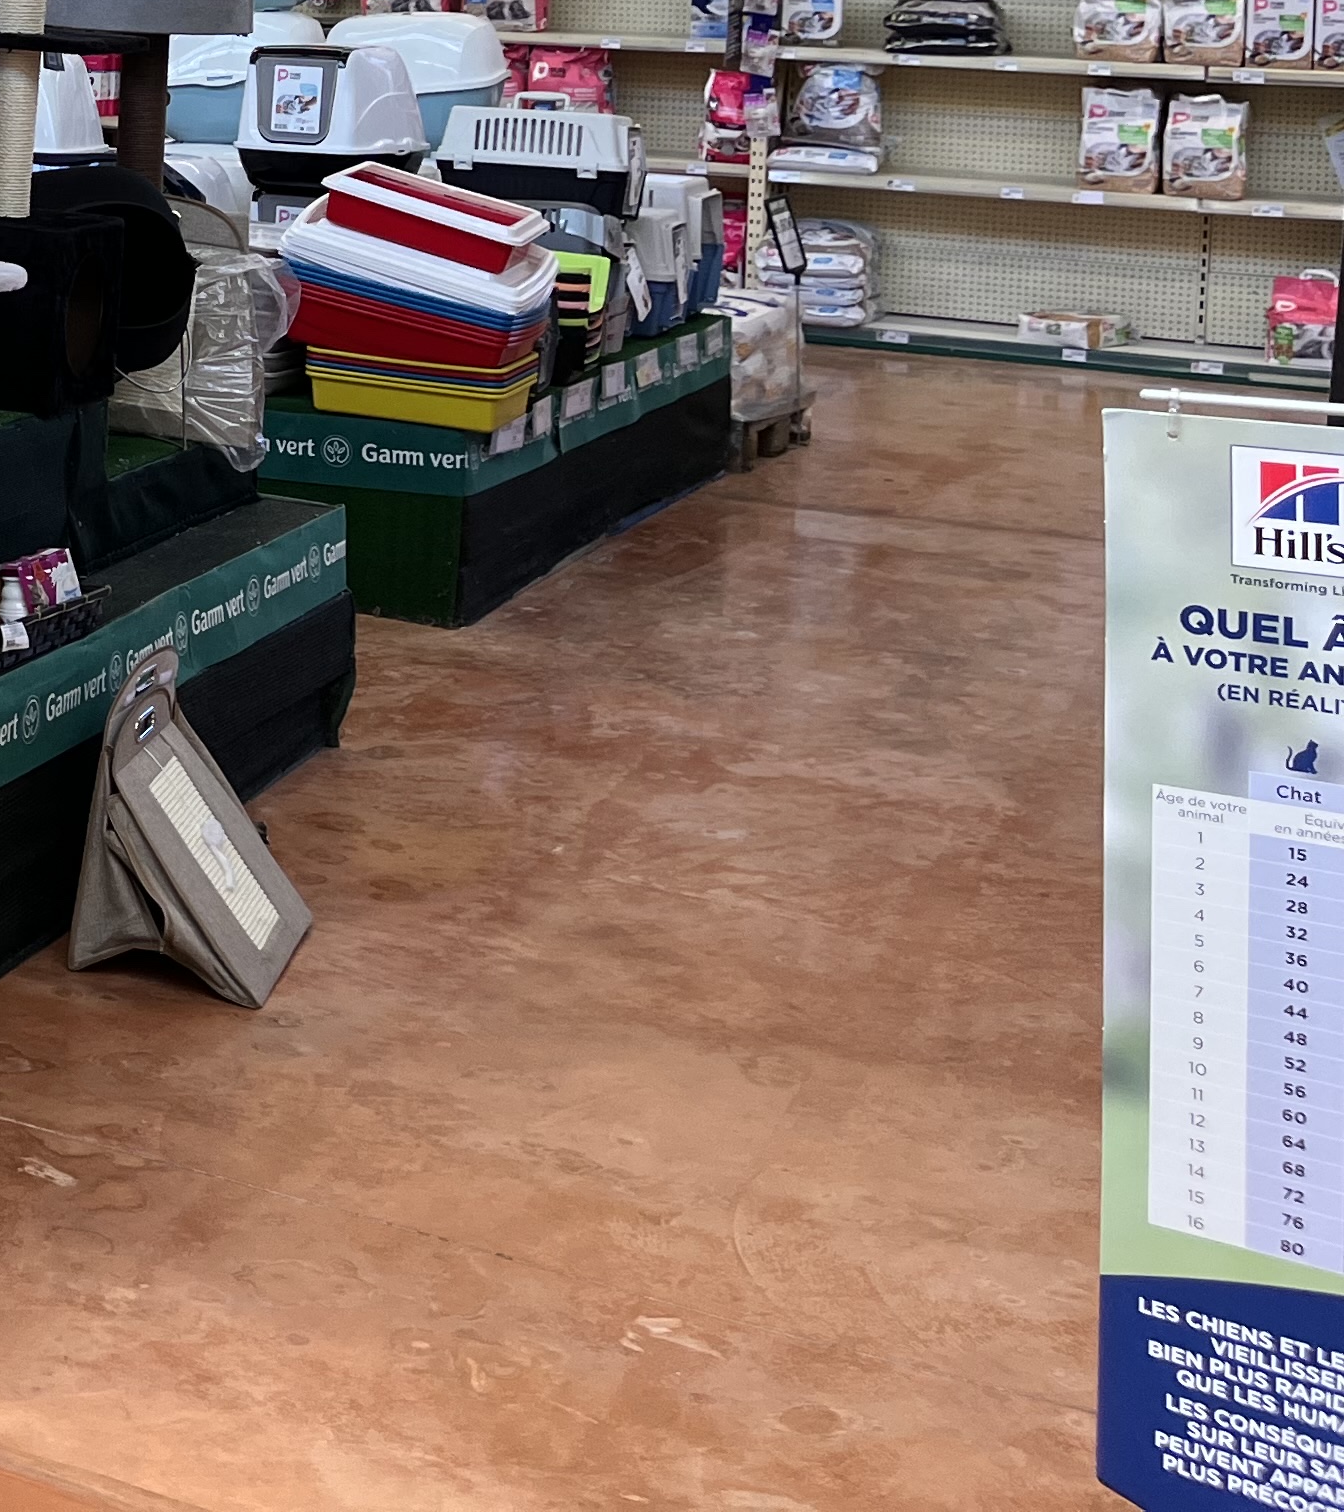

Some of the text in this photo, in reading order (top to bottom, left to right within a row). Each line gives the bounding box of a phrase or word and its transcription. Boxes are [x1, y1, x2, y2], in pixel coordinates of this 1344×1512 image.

[275, 436, 470, 470] vert Gamm vert
[1230, 573, 1328, 597] Transforming
[1180, 604, 1310, 649] QUEL
[44, 686, 82, 723] Gamm
[82, 667, 107, 700] vert
[190, 606, 223, 637] Gamm
[224, 590, 246, 618] vert
[263, 571, 291, 600] Gamm
[290, 557, 309, 588] vert
[1151, 636, 1175, 664] À
[1183, 645, 1289, 679] VOTRE
[1217, 683, 1344, 715] (EN RÉALI
[1276, 784, 1323, 804] Chat
[1188, 796, 1206, 809] de
[1210, 801, 1248, 815] votre
[1177, 807, 1225, 825] animal
[1274, 823, 1292, 835] en
[1197, 831, 1204, 844] 1
[1288, 847, 1307, 862] 15
[1195, 857, 1205, 871] 2
[1286, 873, 1309, 888] 24
[1195, 883, 1205, 896] 3
[1286, 899, 1308, 915] 28
[1194, 909, 1205, 922] 4
[1194, 934, 1205, 948] 5
[1285, 925, 1308, 941] 32
[1193, 960, 1205, 973] 6
[1285, 951, 1308, 967] 36
[1193, 986, 1204, 999] 7
[1283, 978, 1309, 994] 40
[1193, 1011, 1204, 1025] 8
[1283, 1004, 1309, 1021] 44
[1193, 1036, 1204, 1051] 9
[1283, 1031, 1308, 1047] 48
[1189, 1061, 1207, 1077] 10
[1283, 1056, 1307, 1073] 52
[1191, 1088, 1204, 1101] 11
[1283, 1083, 1306, 1099] 56
[1189, 1113, 1206, 1128] 12
[1281, 1108, 1307, 1126] 60
[1188, 1138, 1205, 1154] 13
[1282, 1135, 1306, 1151] 64
[1188, 1164, 1205, 1179] 14
[1282, 1160, 1306, 1177] 68
[1187, 1190, 1204, 1205] 15
[1281, 1187, 1305, 1204] 72
[1186, 1214, 1204, 1230] 16
[1281, 1213, 1305, 1230] 76
[1279, 1239, 1305, 1257] 80
[1138, 1296, 1180, 1324] LES
[1185, 1310, 1275, 1351] CHIENS
[1279, 1335, 1312, 1362] ET
[1147, 1339, 1204, 1372] BIEN
[1208, 1356, 1270, 1389] PLUS
[1175, 1368, 1229, 1401] QUE
[1233, 1385, 1278, 1414] LES
[1164, 1392, 1210, 1421] LES
[1154, 1429, 1267, 1479] PEUVENT
[1186, 1420, 1237, 1451] SUR
[1240, 1436, 1306, 1474] LEUR
[1162, 1452, 1342, 1512] PLUS PRÉCOC
